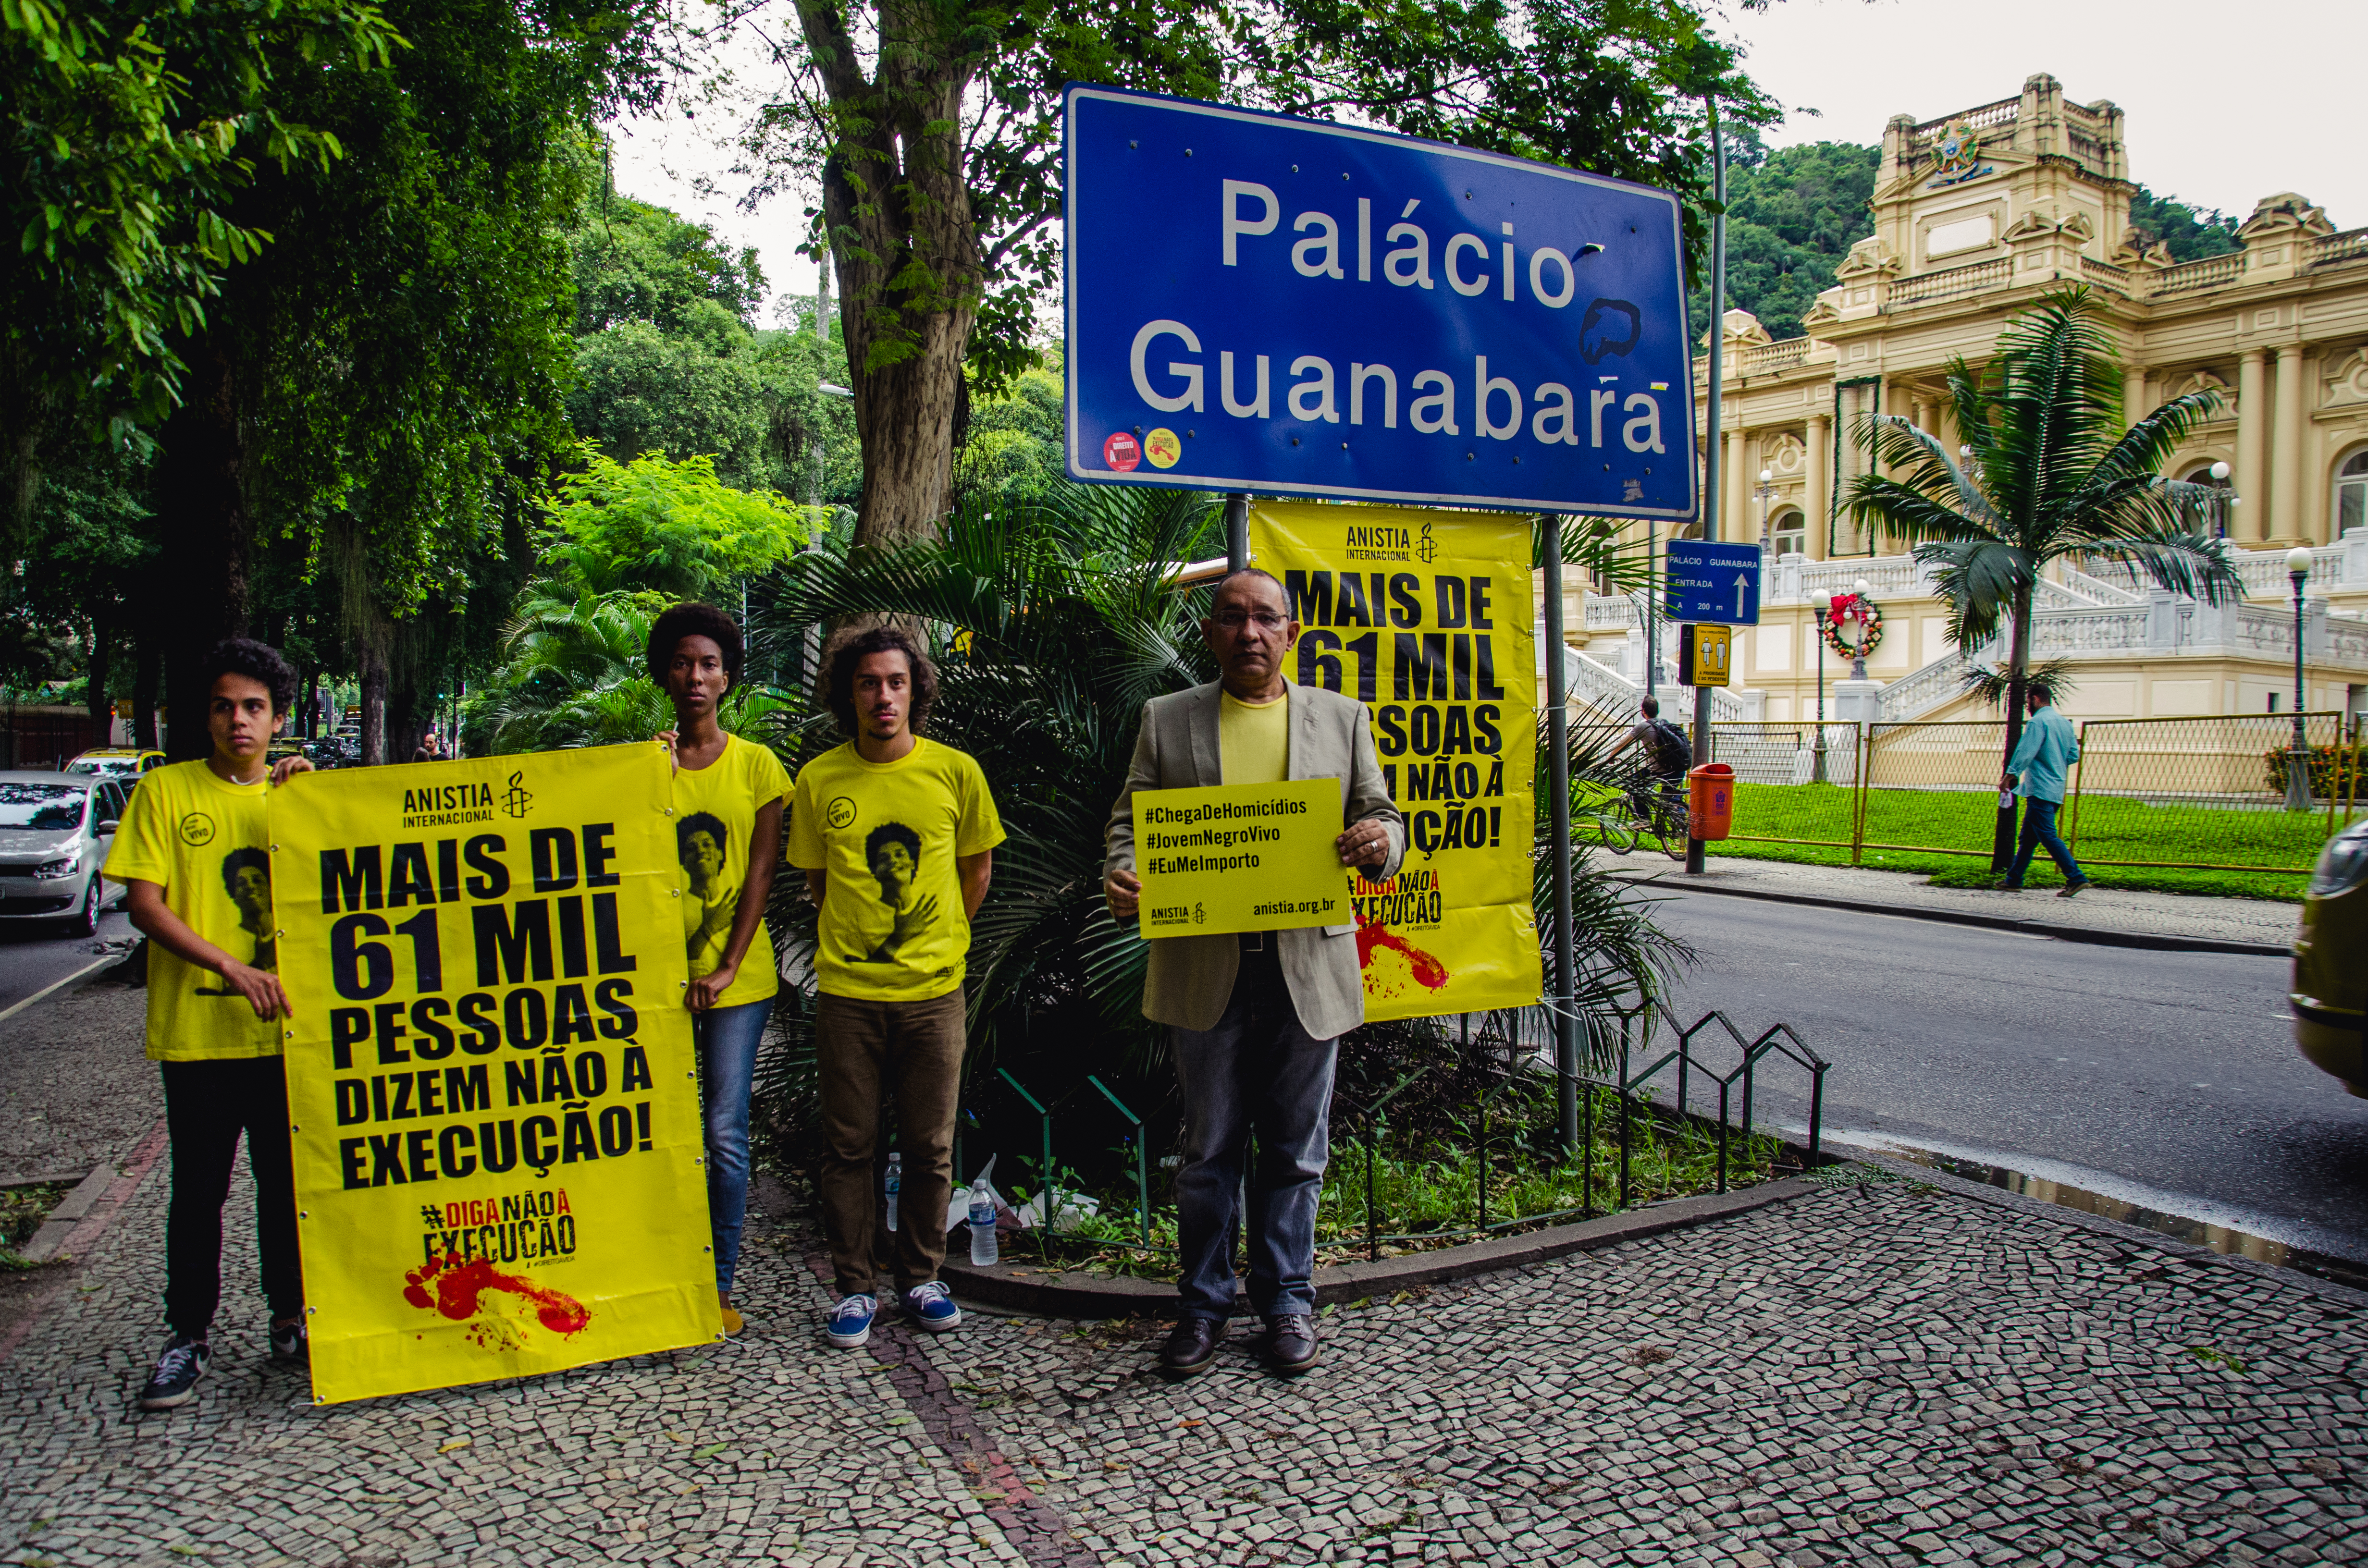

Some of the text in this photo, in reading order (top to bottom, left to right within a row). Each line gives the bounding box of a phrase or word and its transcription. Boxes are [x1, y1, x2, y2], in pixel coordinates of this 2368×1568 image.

[1222, 179, 1575, 308] Palácio
[1130, 319, 1666, 454] Guanabara
[1346, 526, 1411, 549] ANISTIA
[1346, 549, 1411, 562] INTERNACIONAL
[1675, 579, 1713, 588] ENTRADA
[1710, 559, 1758, 569] GUANABARA
[1284, 570, 1493, 630] MAIS DE
[1297, 629, 1504, 702] 61 MIL
[1368, 704, 1502, 757] SOAS
[404, 783, 494, 813] ANISTIA
[1407, 755, 1479, 801] NÃO
[1483, 754, 1504, 797] À
[403, 809, 494, 828] INTERNACIONAL
[1145, 799, 1307, 825] #ChegaDeHomicídios
[1147, 825, 1280, 849] #JovemNegroVivo
[320, 822, 620, 915] MAIS DE
[1148, 853, 1259, 874] #EuMeImporto
[1151, 906, 1189, 919] ANISTIA
[1253, 898, 1335, 916] anistia.org.br
[330, 892, 637, 1001] 61 MIL
[330, 978, 639, 1070] PESSOAS
[334, 1038, 654, 1126] DIZEM NÃO À
[339, 1100, 654, 1190] EXECUÇÃO!
[423, 1215, 576, 1269] EXECUÇÃO
